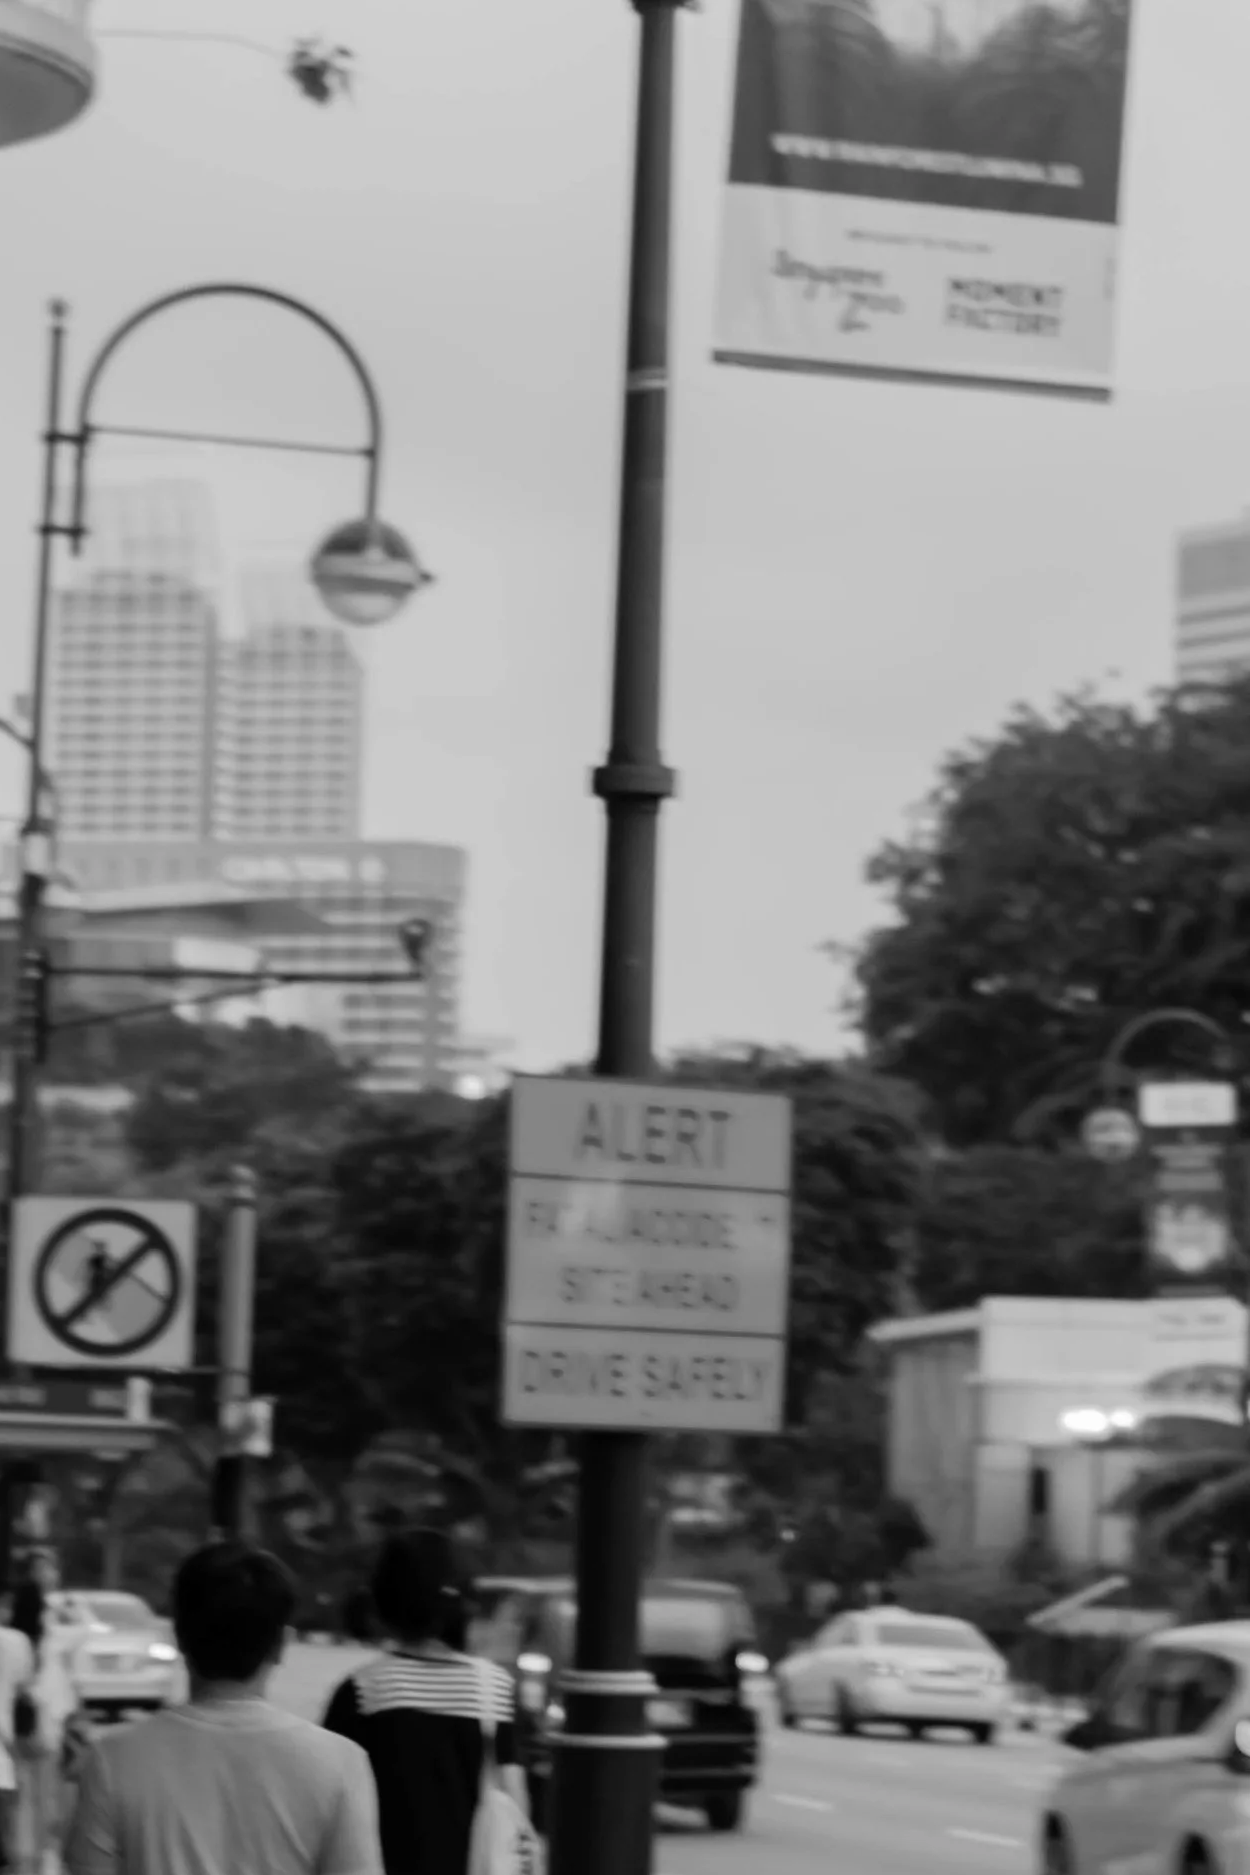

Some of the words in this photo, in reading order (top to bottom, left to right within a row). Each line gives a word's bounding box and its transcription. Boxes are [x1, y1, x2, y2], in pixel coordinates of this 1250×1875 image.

[575, 1102, 733, 1169] ALERT
[518, 1348, 627, 1398] DRIVE
[642, 1354, 772, 1402] SAFELY
